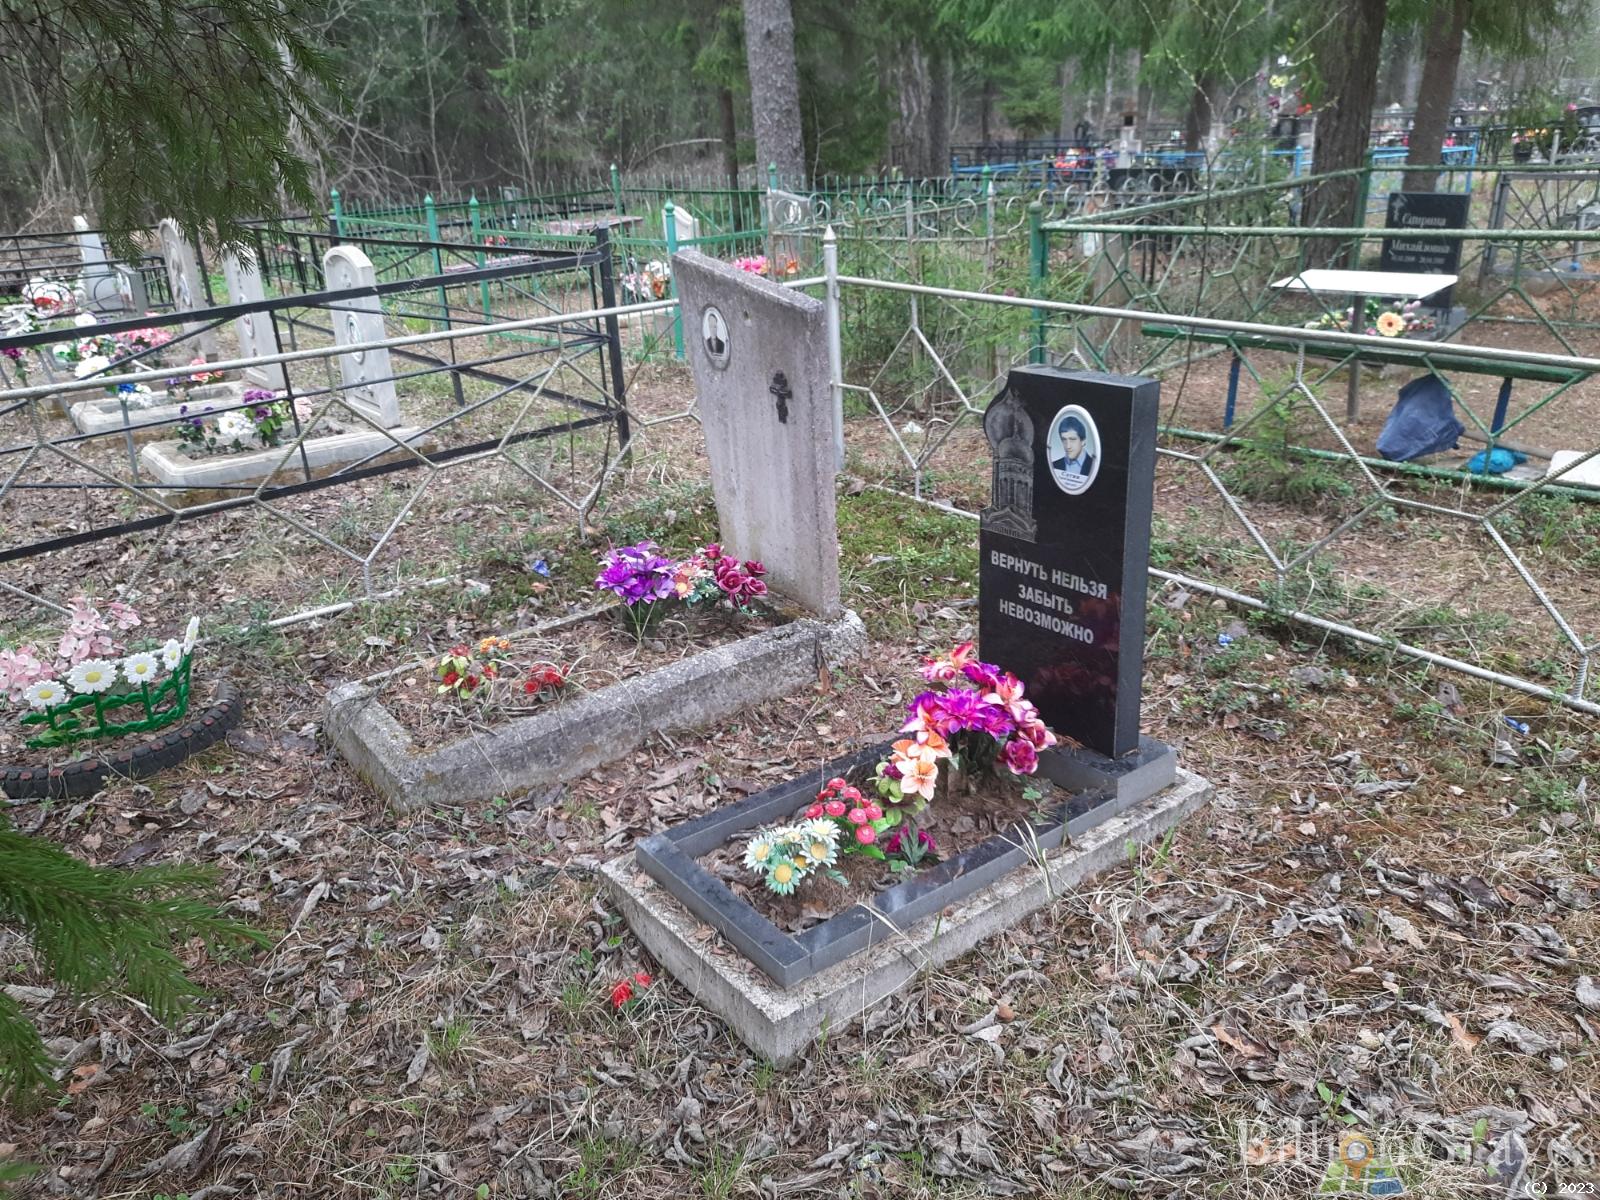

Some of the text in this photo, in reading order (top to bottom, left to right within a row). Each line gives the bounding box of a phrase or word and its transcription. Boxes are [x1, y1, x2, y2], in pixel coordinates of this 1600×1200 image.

[991, 550, 1108, 600] ВЕРНУТЬ НЕЛЬЗЯ
[999, 598, 1094, 644] НЕВОЗМОЖНО
[1018, 584, 1073, 615] ЗАБЫТЬ
